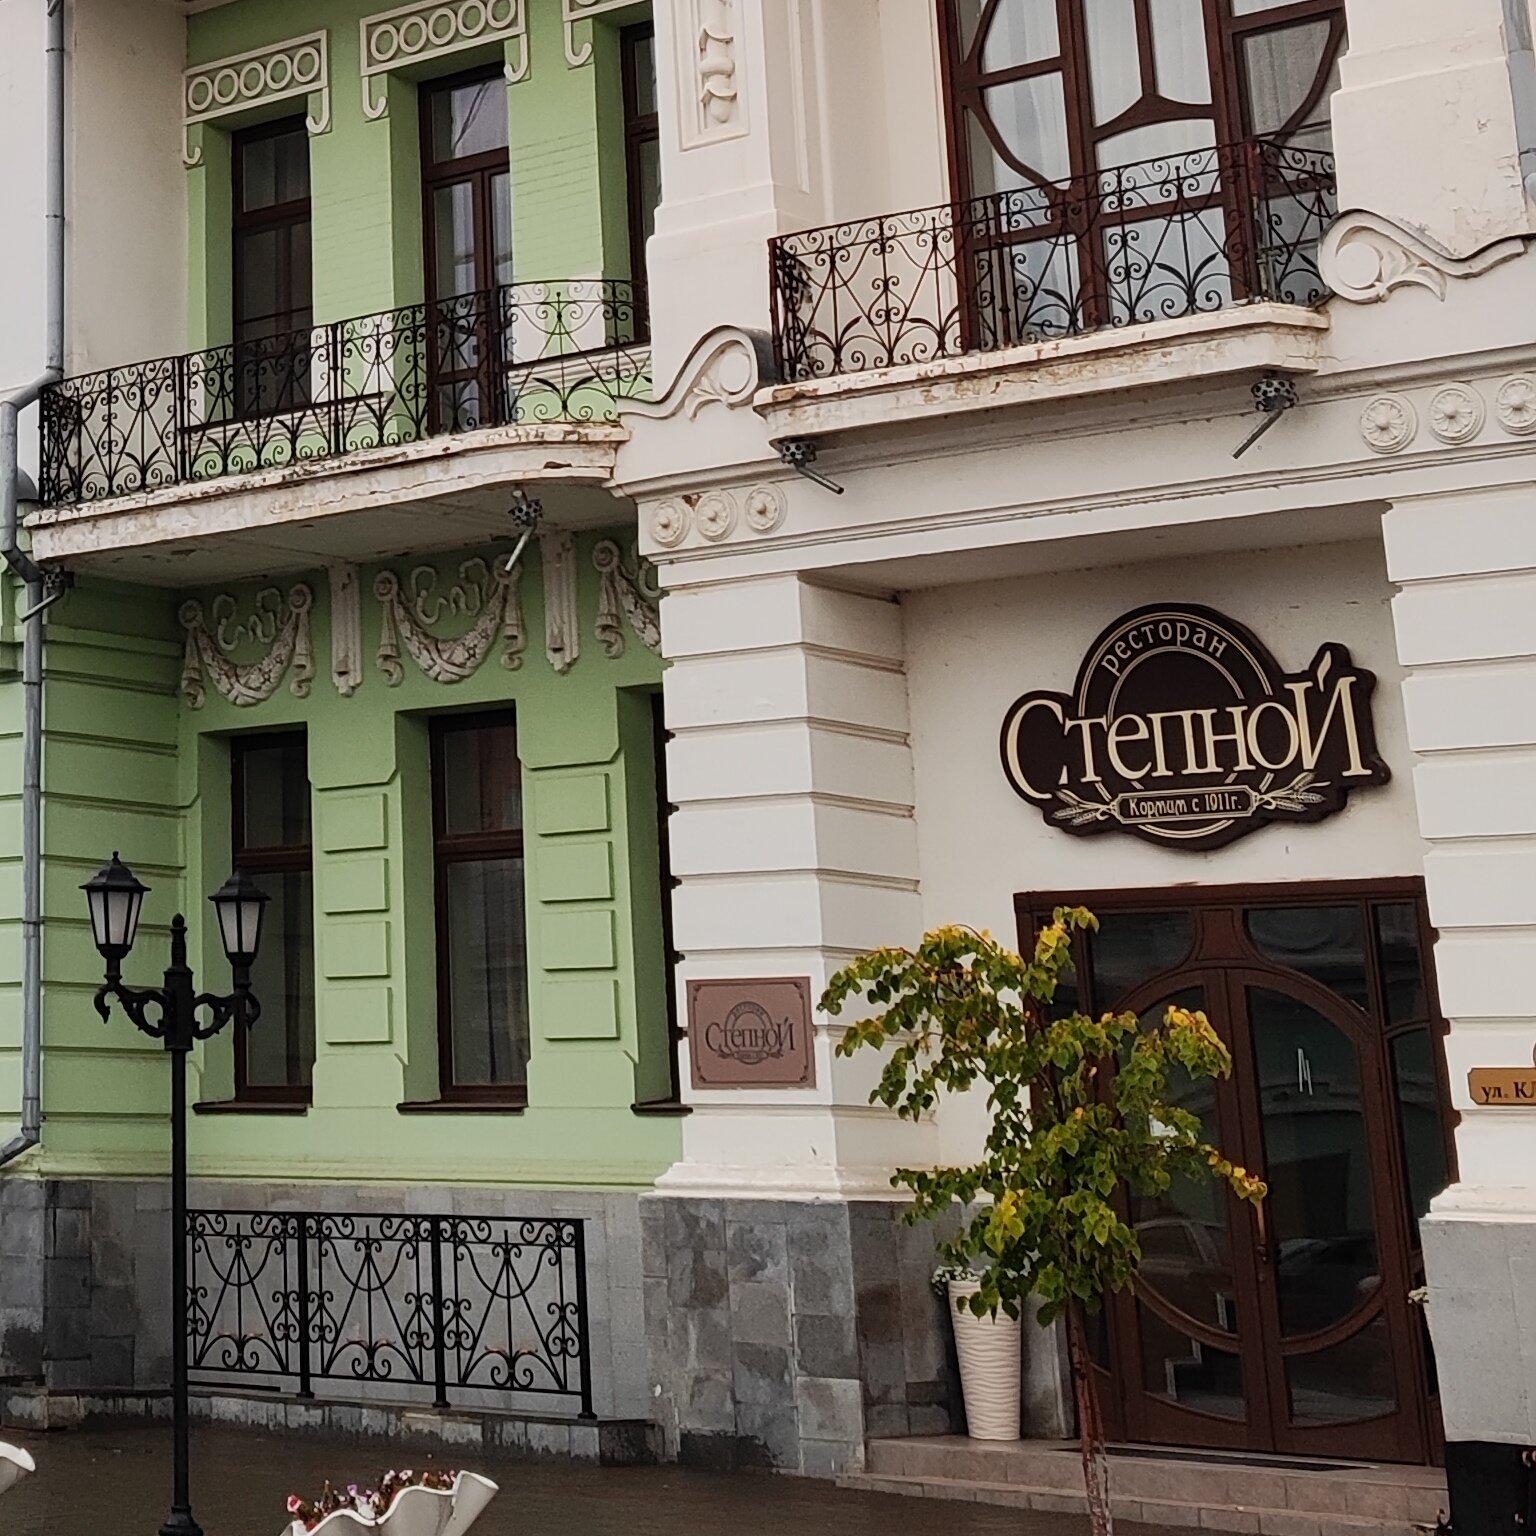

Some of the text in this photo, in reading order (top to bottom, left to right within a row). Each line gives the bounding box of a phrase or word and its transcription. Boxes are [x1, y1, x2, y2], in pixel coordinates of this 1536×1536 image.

[1101, 621, 1227, 677] ресторан
[1129, 798, 1187, 818] Кормим
[1192, 798, 1200, 812] с
[1481, 1086, 1509, 1102] ул.
